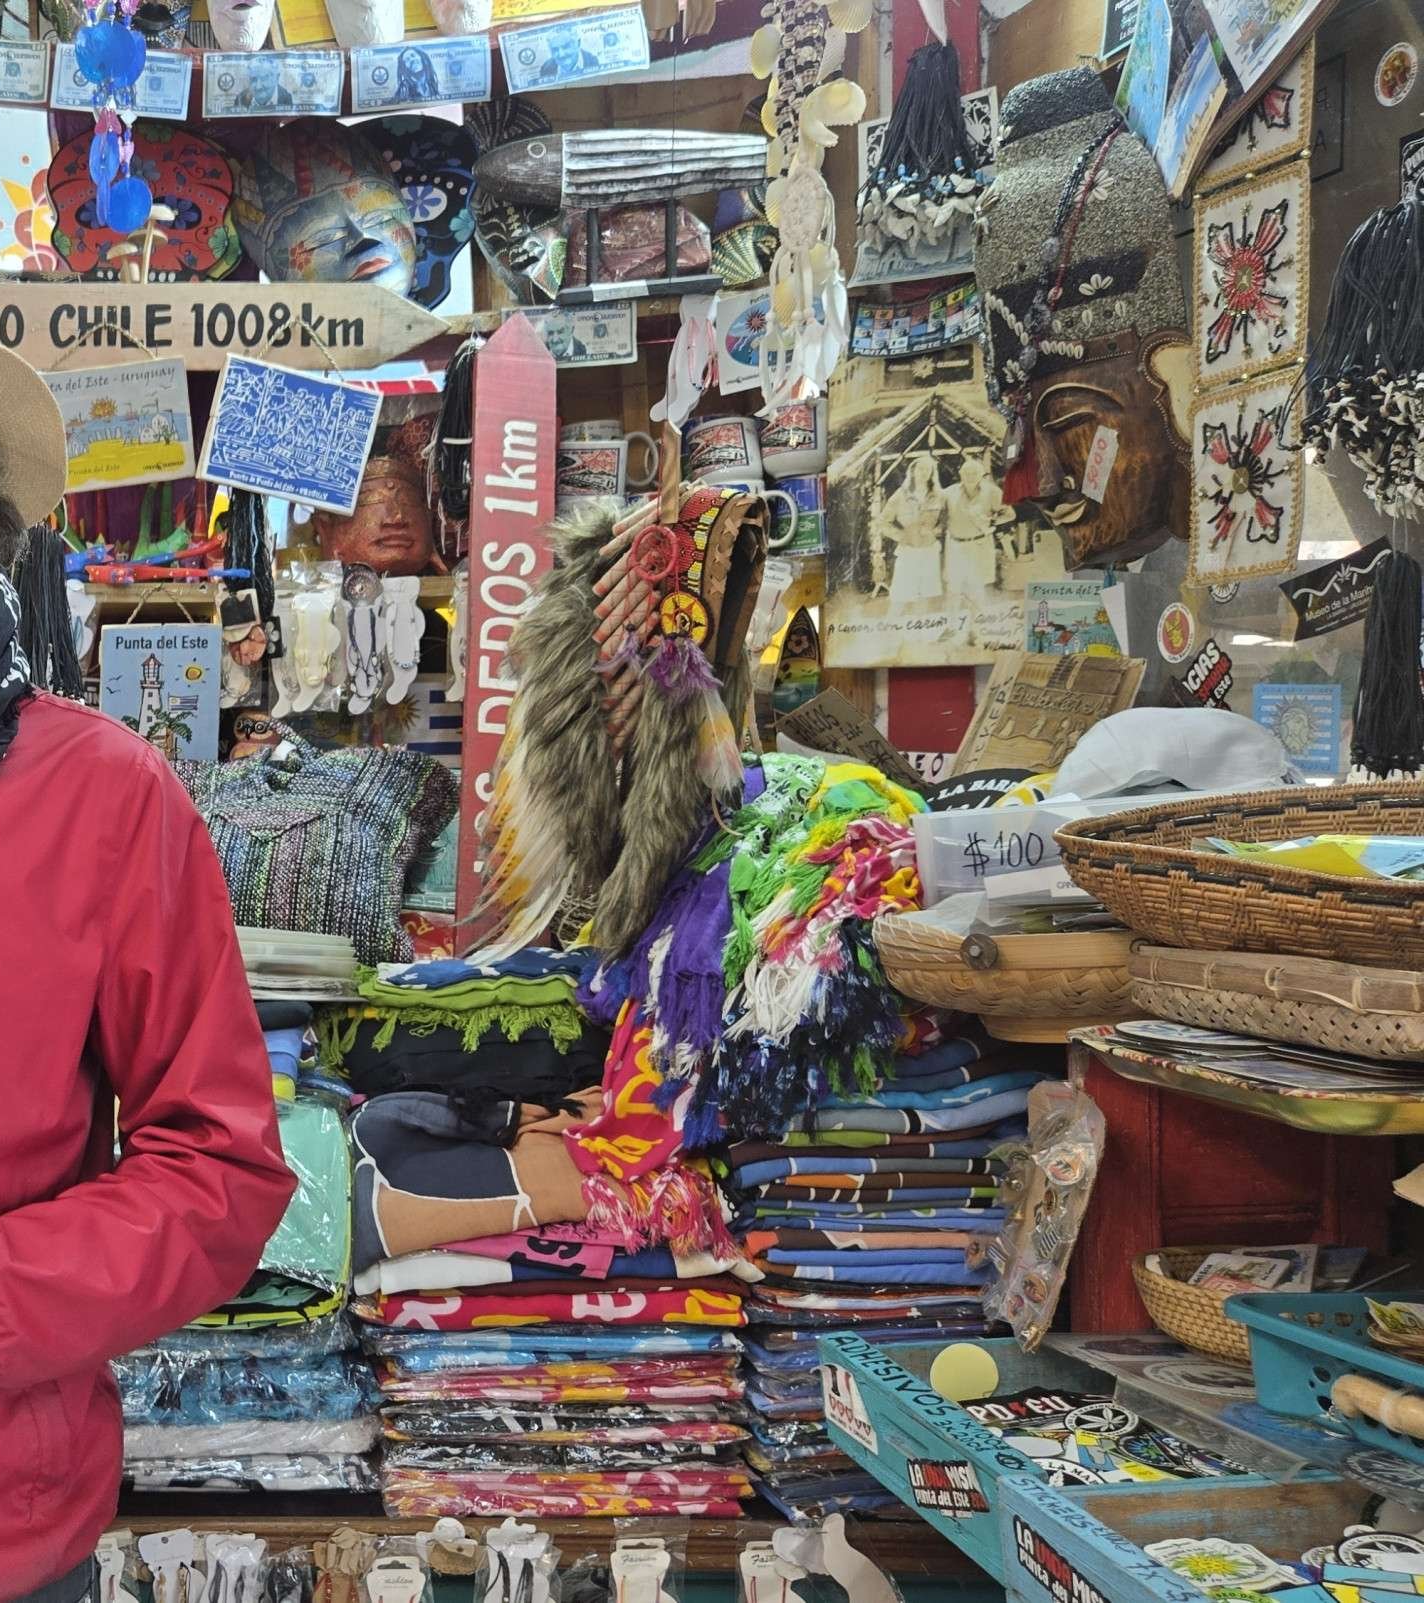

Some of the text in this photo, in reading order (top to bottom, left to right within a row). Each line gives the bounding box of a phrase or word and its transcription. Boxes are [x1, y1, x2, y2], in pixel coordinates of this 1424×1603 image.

[49, 304, 172, 347] CHILE
[66, 378, 81, 393] del
[86, 375, 109, 389] Este
[1033, 585, 1074, 597] Punta
[1305, 604, 1330, 621] Museo
[1331, 600, 1342, 611] de
[116, 635, 209, 649] Punta del Este
[962, 830, 1044, 877] $100
[828, 1336, 958, 1416] ADHESIVOS
[909, 1463, 925, 1487] LA
[1016, 1519, 1034, 1555] LA
